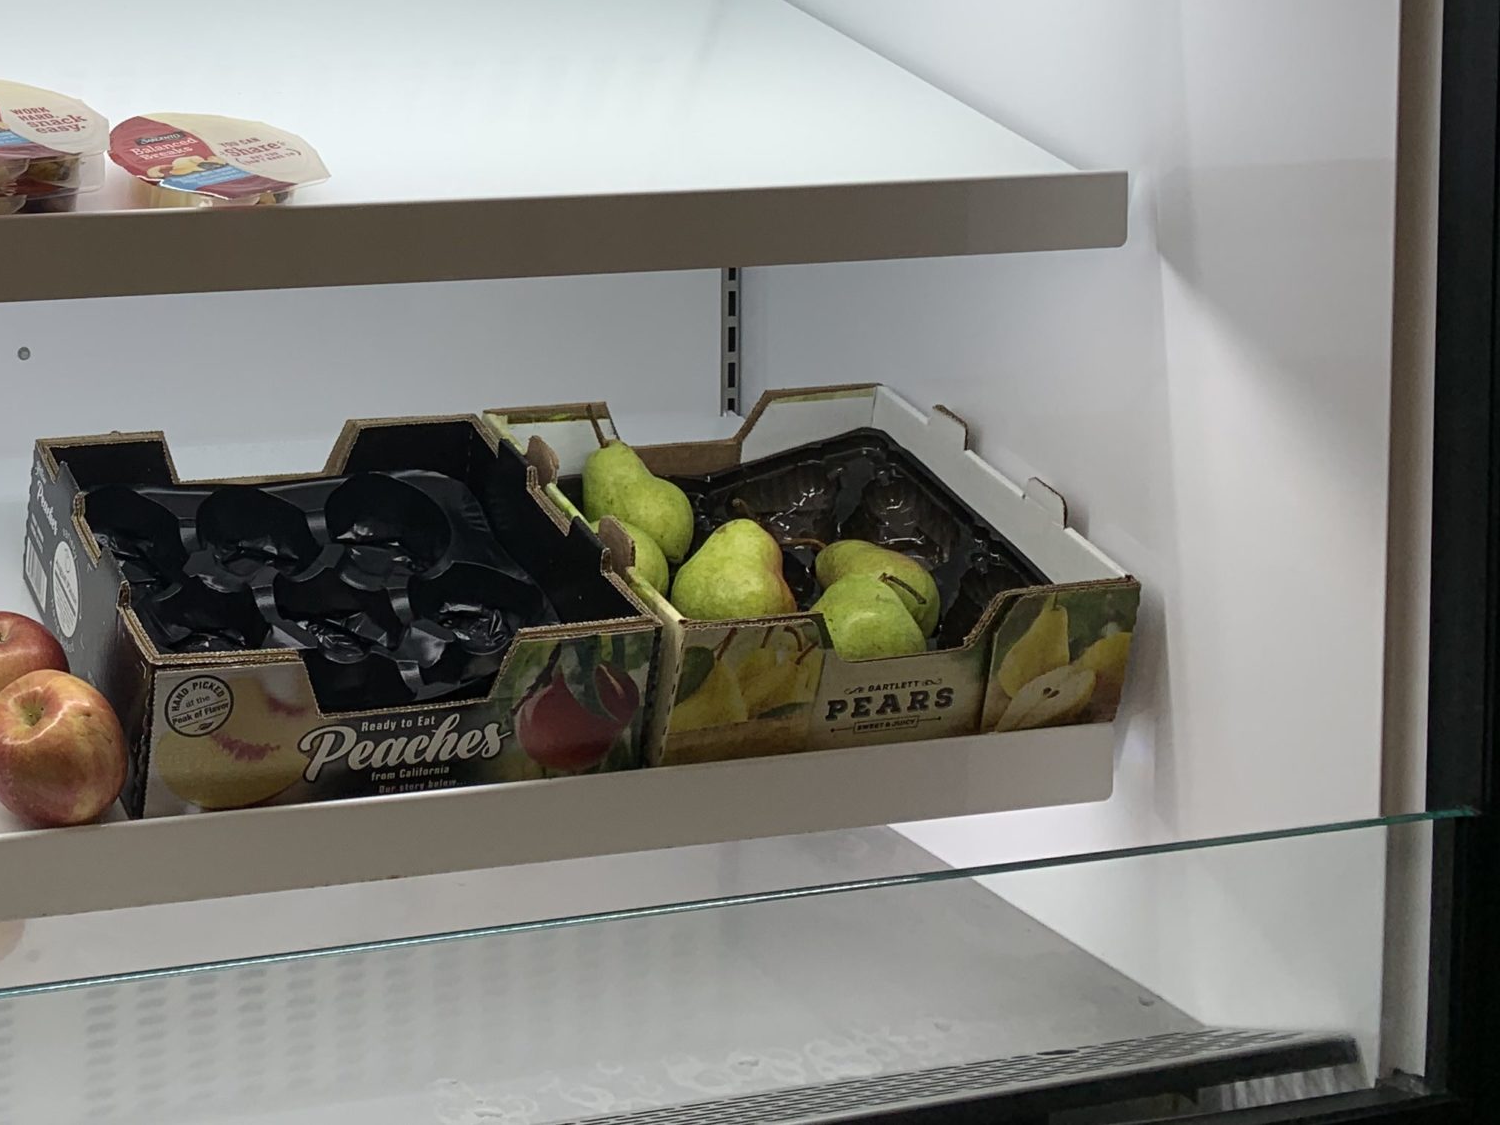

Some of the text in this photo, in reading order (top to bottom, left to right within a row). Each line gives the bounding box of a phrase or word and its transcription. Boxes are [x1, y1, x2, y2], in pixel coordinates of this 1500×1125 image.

[10, 107, 51, 115] WORK
[27, 115, 87, 128] snack
[130, 137, 198, 156] Balanced
[141, 147, 193, 161] Breaks
[868, 680, 919, 693] BARTLETT
[171, 682, 225, 712] HAND PICKED
[196, 695, 210, 704] the
[825, 687, 954, 721] PEARS
[172, 715, 192, 725] Peak
[205, 702, 229, 715] Flavor
[362, 716, 436, 731] Ready to Eat
[857, 723, 884, 731] SWEET
[892, 719, 915, 728] JUICY
[299, 713, 512, 782] Peaches
[371, 766, 450, 781] from California
[399, 782, 425, 793] story
